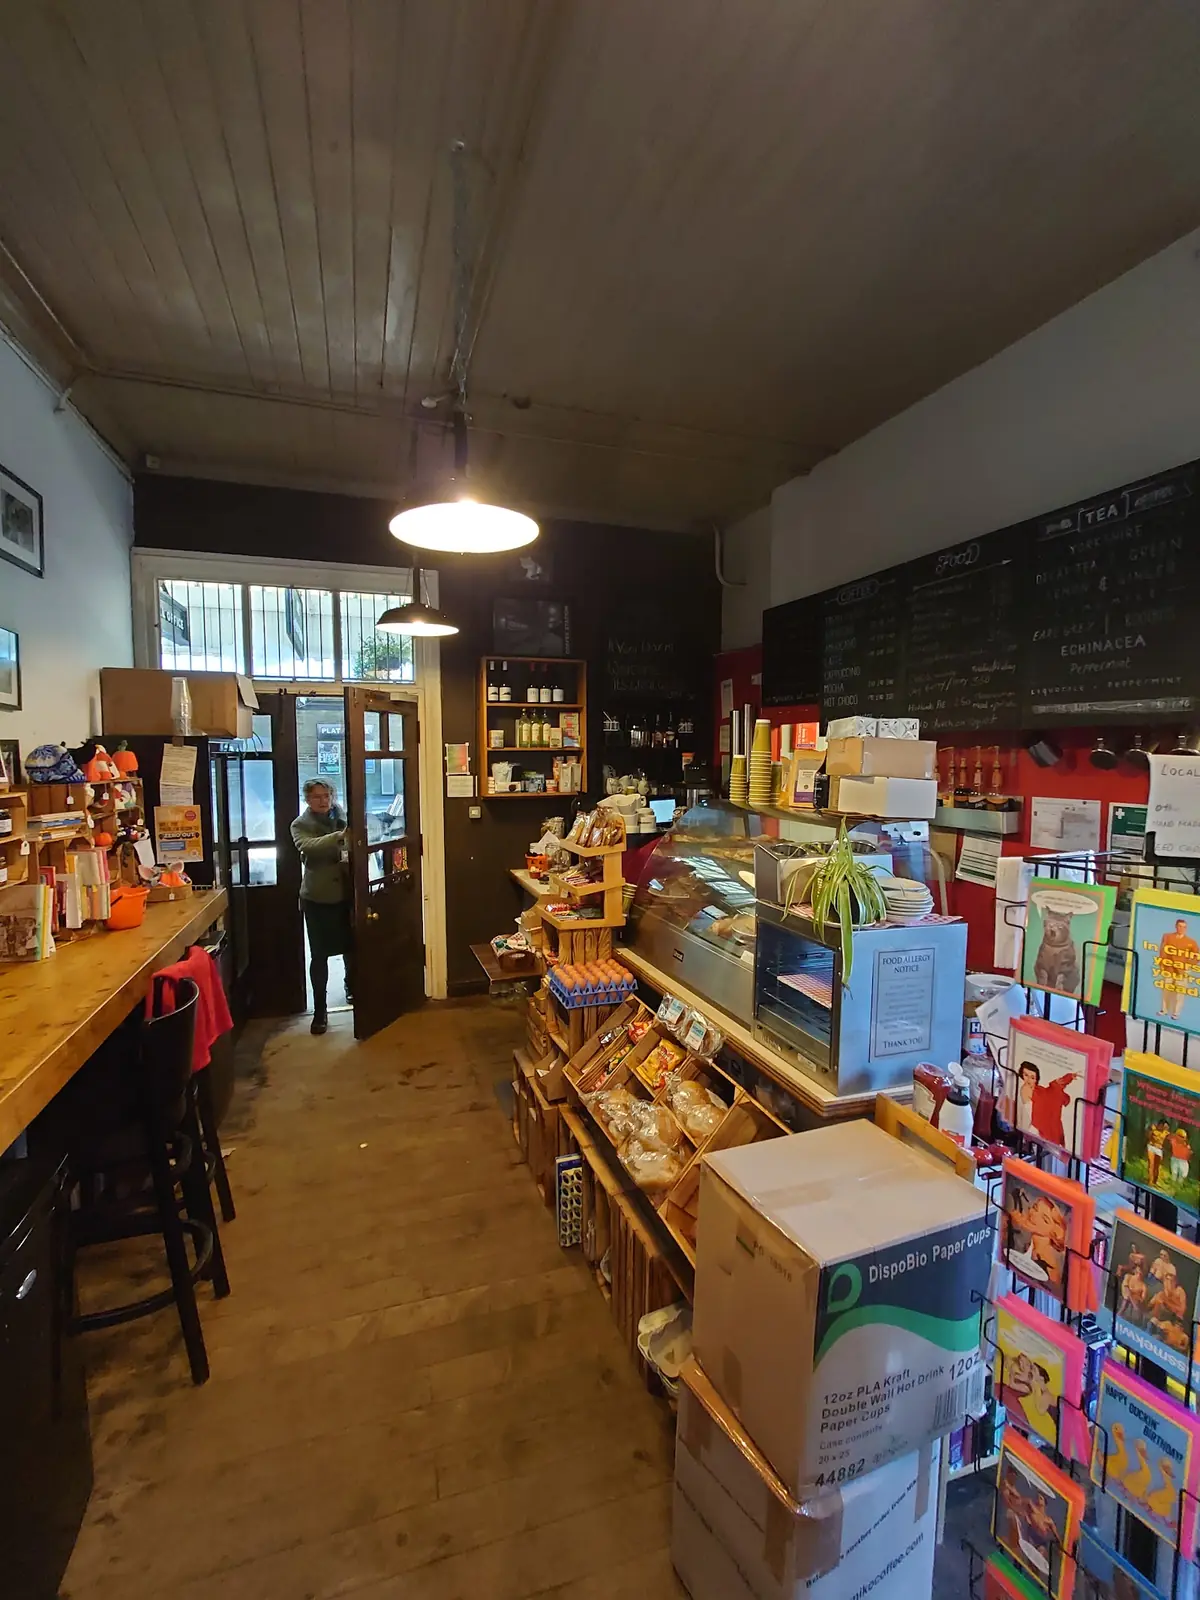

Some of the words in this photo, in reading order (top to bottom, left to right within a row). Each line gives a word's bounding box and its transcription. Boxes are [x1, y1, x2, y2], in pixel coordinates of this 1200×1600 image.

[1085, 504, 1119, 525] TEA
[1060, 634, 1147, 657] ECHINACEA
[823, 683, 844, 694] MOCHA
[1107, 676, 1183, 690] PEPPERMINT
[823, 696, 835, 708] HOT
[838, 694, 858, 706] CHOCO
[1143, 940, 1159, 952] In
[882, 957, 902, 965] FOOD
[903, 954, 931, 964] ALLERGY
[894, 964, 920, 973] NOTICE
[884, 1039, 908, 1049] THANK
[909, 1036, 923, 1047] YOU
[869, 1251, 927, 1284] DispoBio
[932, 1238, 966, 1262] Paper
[967, 1226, 991, 1248] Cups
[949, 1351, 980, 1380] 12oz
[822, 1400, 867, 1419] Double
[870, 1387, 894, 1406] Wall
[896, 1379, 915, 1395] Hot
[918, 1364, 944, 1386] Drink
[824, 1391, 853, 1405] 12oz
[857, 1381, 881, 1397] PLA
[883, 1368, 910, 1388] Kraft
[1105, 1383, 1128, 1406] HAPPY
[820, 1417, 857, 1434] Paper
[861, 1404, 890, 1422] Cups
[820, 1438, 843, 1450] Case
[818, 1455, 830, 1465] 20
[840, 1449, 851, 1460] 25
[814, 1458, 866, 1487] 44882
